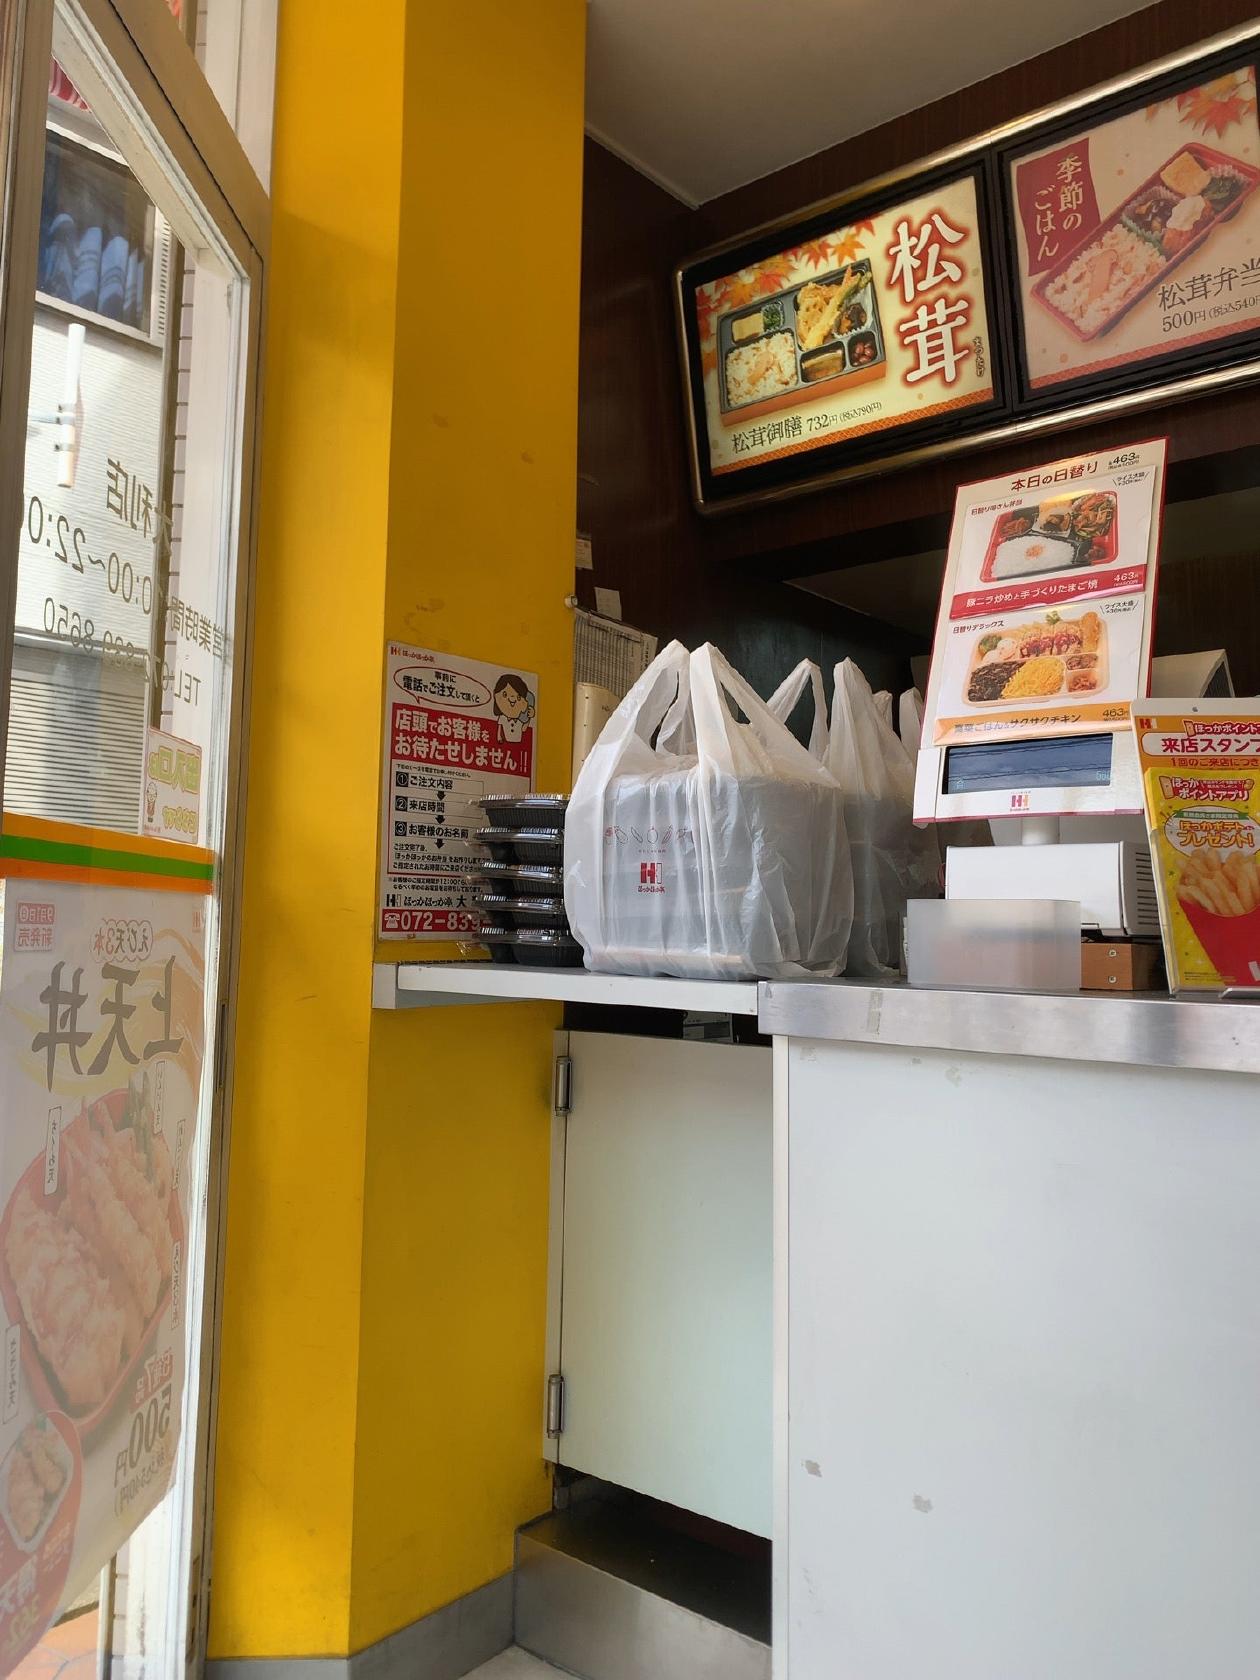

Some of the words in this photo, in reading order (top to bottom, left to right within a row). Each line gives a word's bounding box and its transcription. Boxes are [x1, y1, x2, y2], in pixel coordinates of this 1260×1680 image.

[1056, 155, 1083, 231] 季節の
[1034, 185, 1060, 262] ごはん
[888, 213, 969, 383] 松茸
[1162, 309, 1206, 332] 500円
[731, 415, 802, 453] 松茸御膳
[806, 414, 837, 432] 732円
[1011, 461, 1098, 492] 本日の日替り
[952, 620, 1005, 634] 日替りデラックス
[403, 675, 480, 703] 電話でご注文して頂くと
[395, 708, 490, 743] 店頭でお客様を
[410, 775, 453, 790] ご注文内容
[1178, 788, 1249, 800] ポイントアプリ
[408, 801, 445, 814] 来店時間
[408, 824, 469, 839] お客様のお名前
